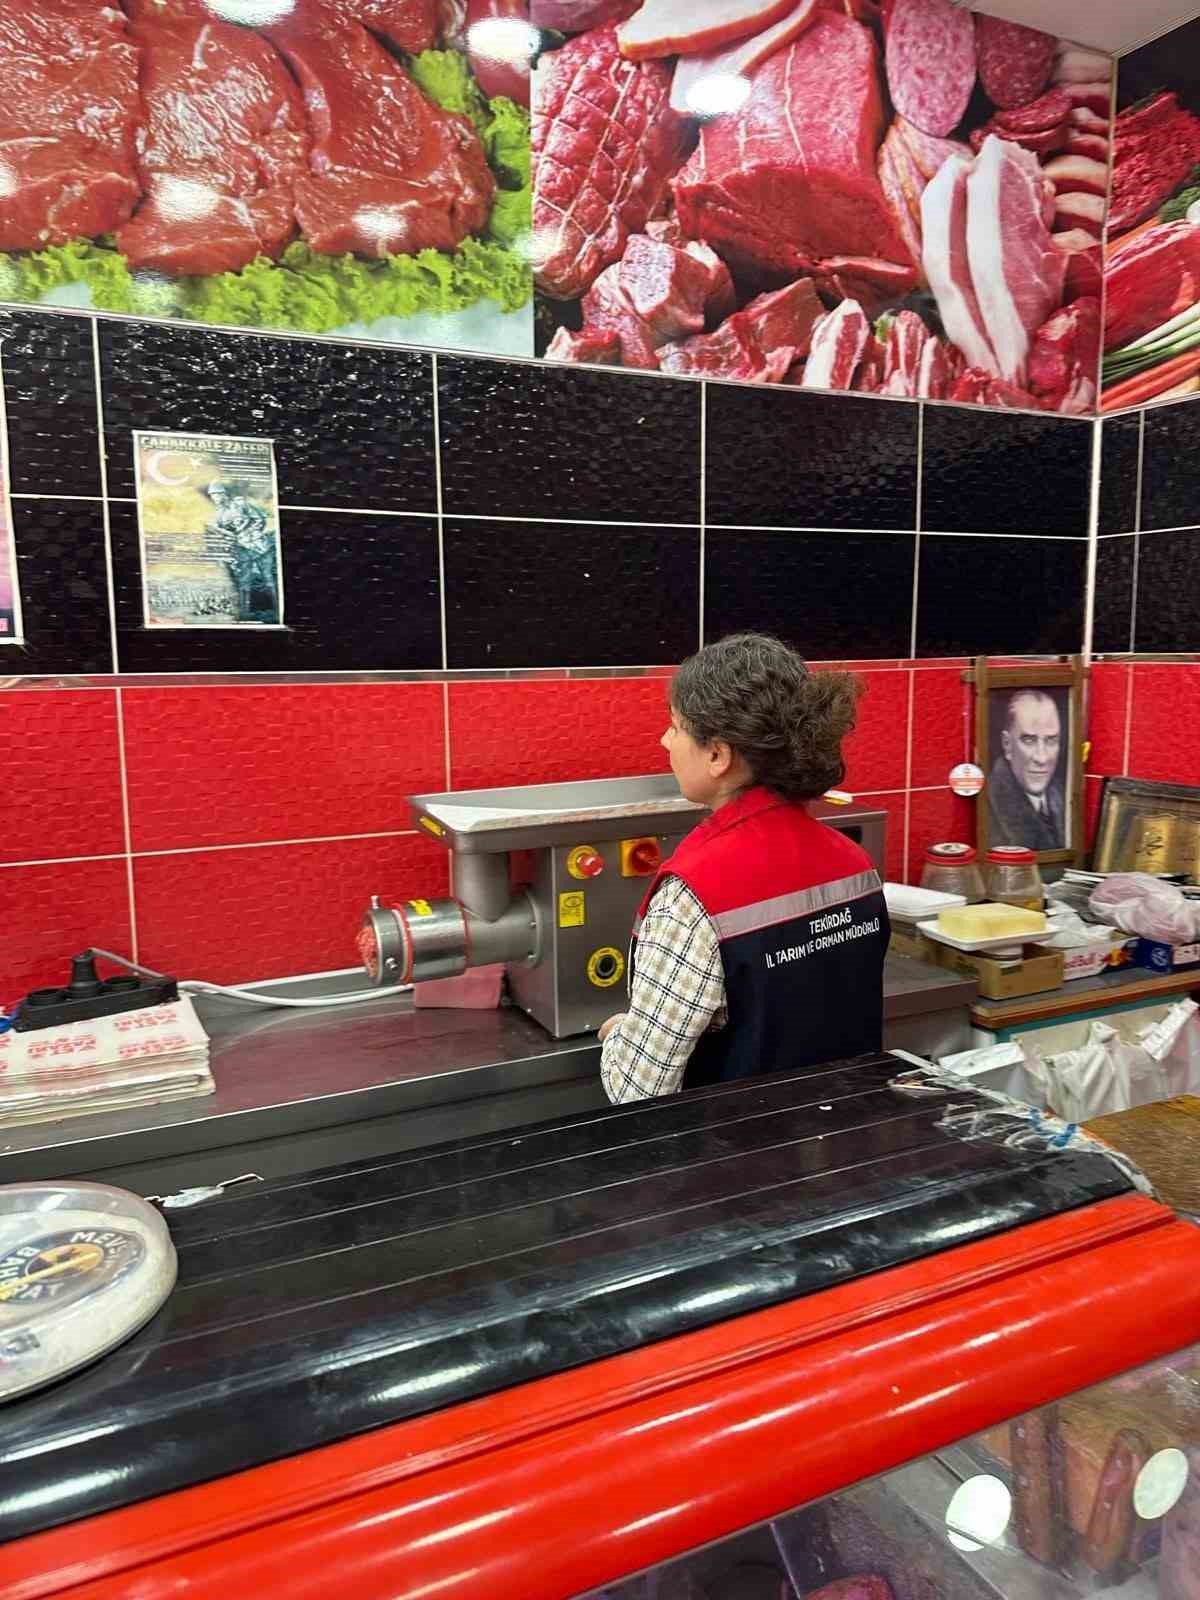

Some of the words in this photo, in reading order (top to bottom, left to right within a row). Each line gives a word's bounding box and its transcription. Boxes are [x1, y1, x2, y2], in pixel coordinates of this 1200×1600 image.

[809, 907, 852, 935] TEKİRDAĞ
[776, 943, 806, 964] TARIM
[806, 940, 815, 954] VE
[815, 930, 845, 950] ORMAN
